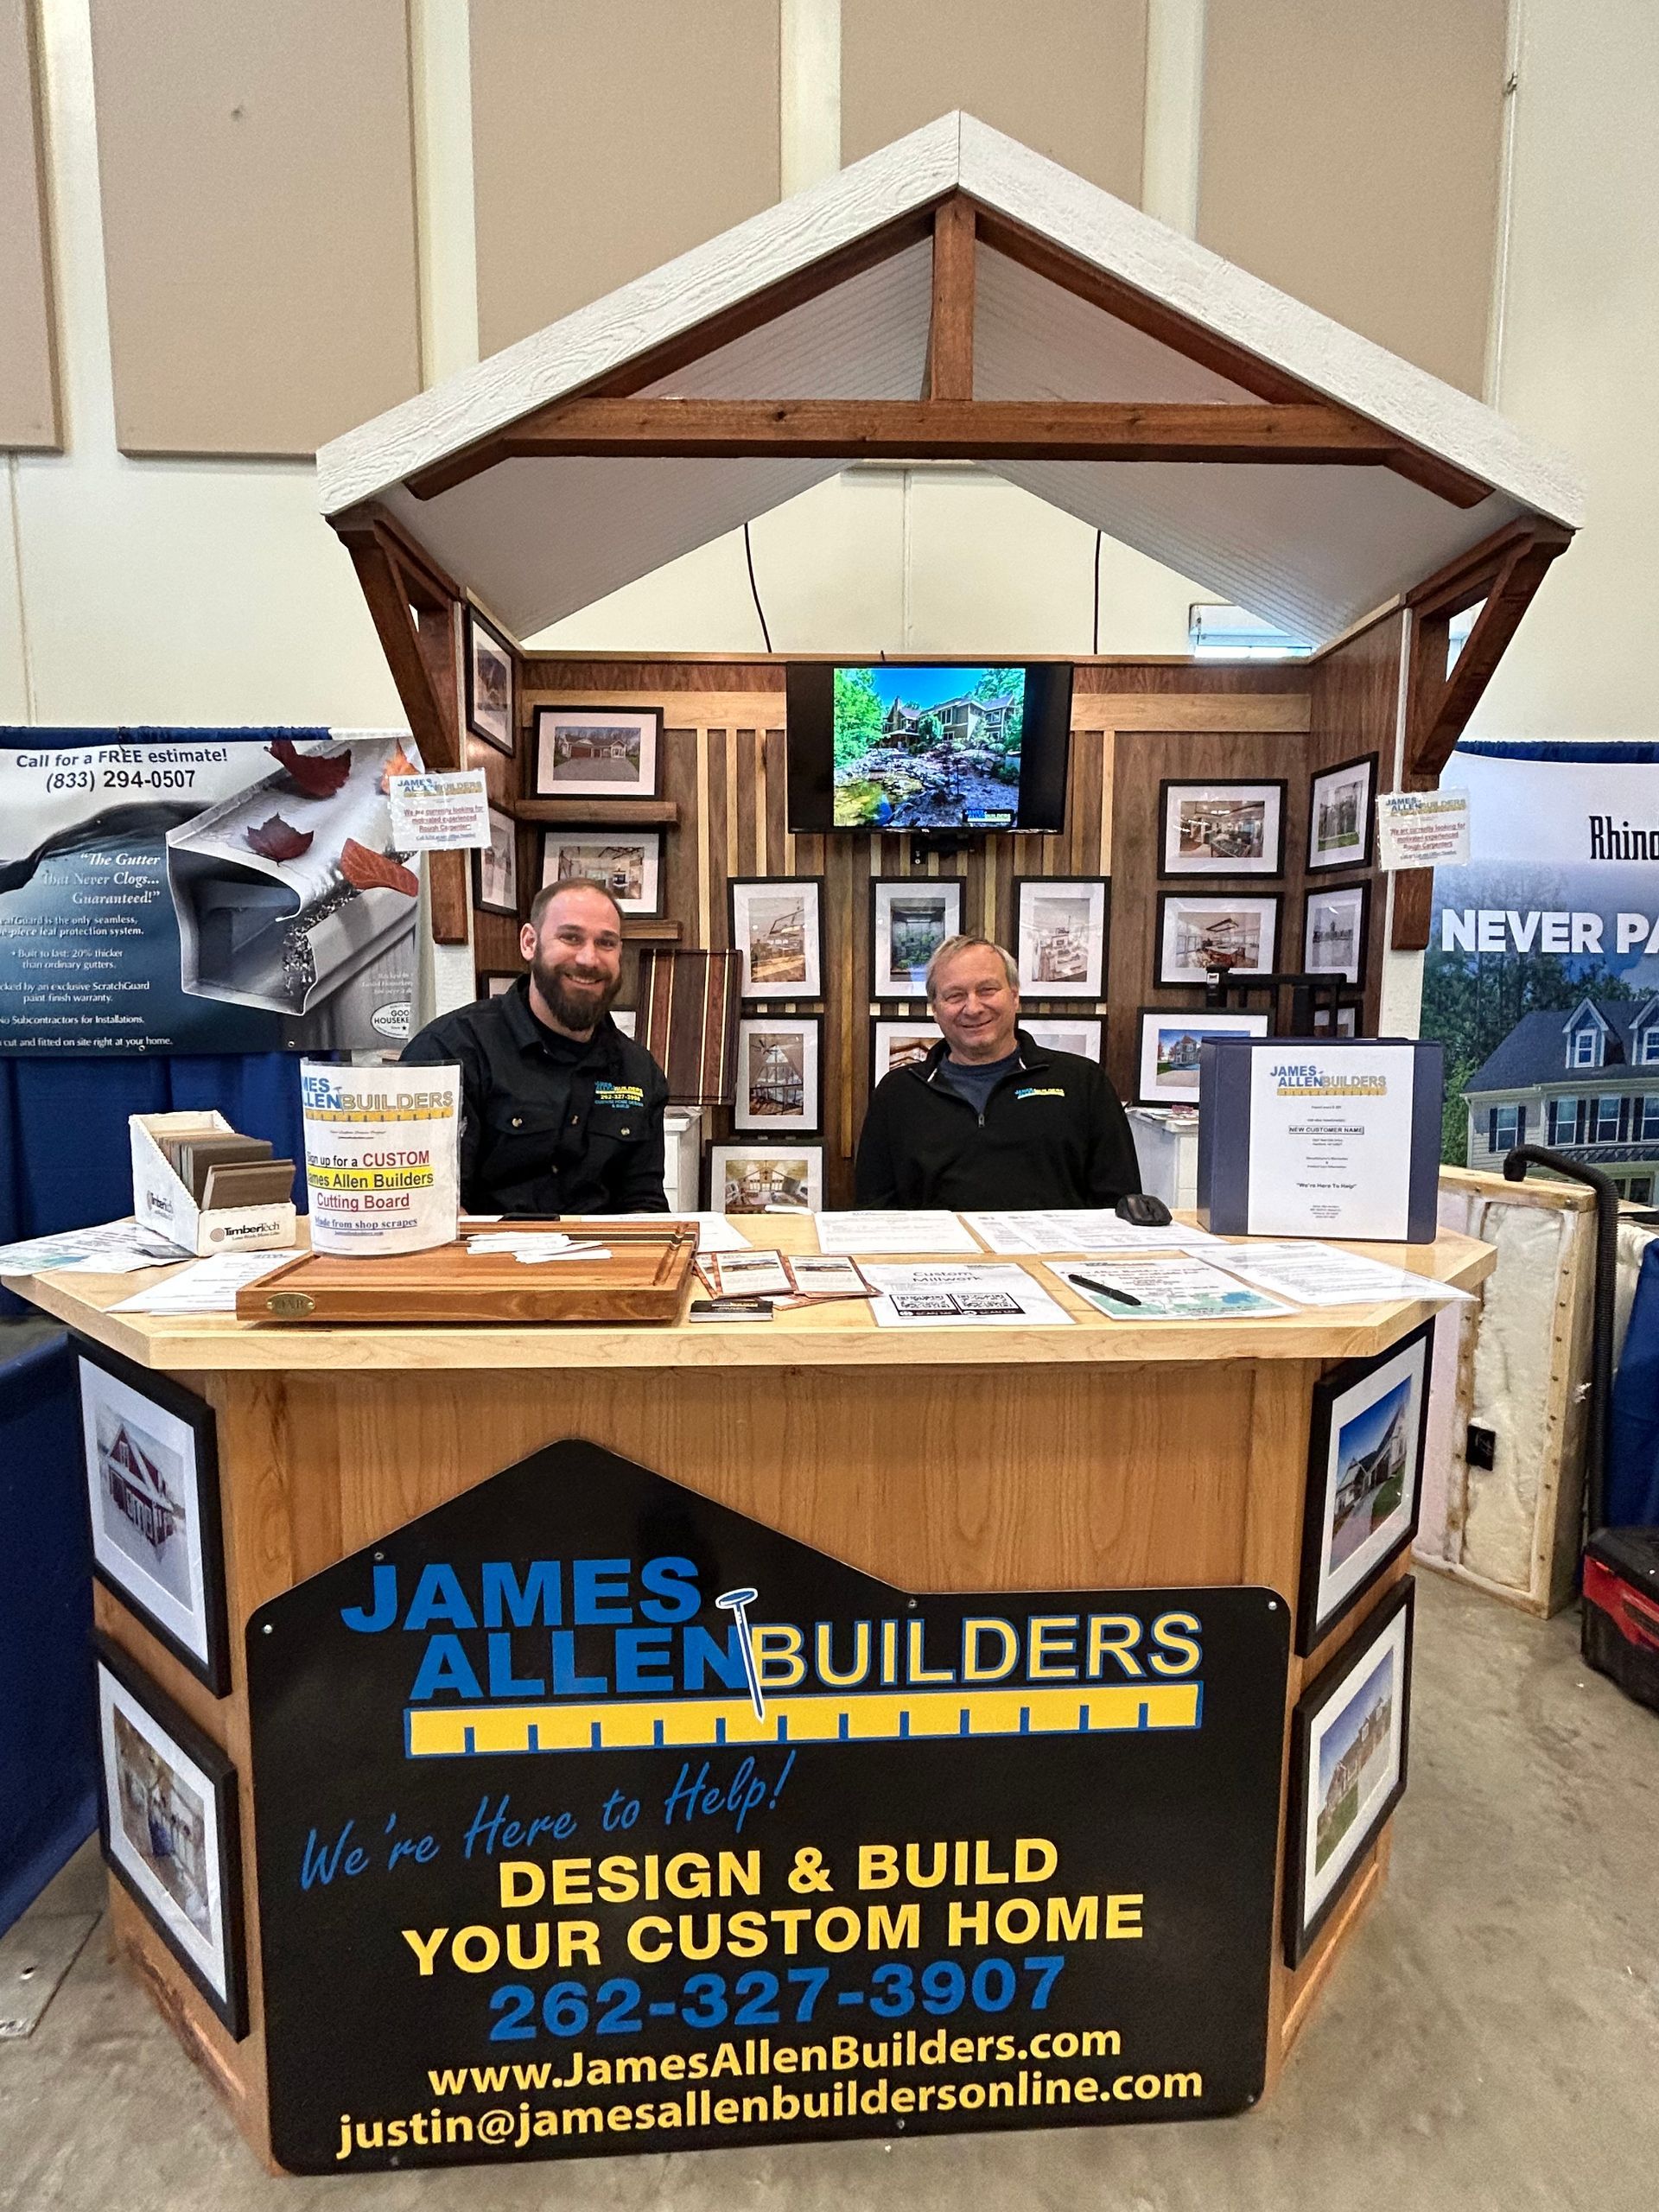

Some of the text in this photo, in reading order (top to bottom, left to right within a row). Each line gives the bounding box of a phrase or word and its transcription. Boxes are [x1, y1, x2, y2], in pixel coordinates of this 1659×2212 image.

[16, 748, 227, 767] Call for a FREE estimate!
[46, 770, 195, 792] (833) 294-0507
[1386, 797, 1417, 805] JAMES
[116, 853, 161, 866] Gutter
[43, 872, 160, 887] That Never Clogs...
[54, 916, 69, 925] the
[72, 915, 91, 925] only
[94, 915, 138, 925] seamless,
[59, 926, 107, 938] protection
[110, 926, 144, 937] system.
[1442, 908, 1605, 954] NEVER
[44, 961, 80, 970] ordinary
[84, 961, 116, 970] gutters.
[23, 982, 35, 993] by
[50, 982, 89, 991] exclusive
[92, 981, 150, 991] ScratchGuard
[23, 994, 113, 1005] paint finish warranty.
[12, 1014, 79, 1025] Subcontractors
[81, 1014, 92, 1023] for
[95, 1014, 145, 1024] Installations.
[20, 1038, 35, 1046] and
[37, 1037, 61, 1046] fitted
[76, 1038, 91, 1046] site
[93, 1037, 112, 1048] right
[125, 1038, 143, 1048] your
[145, 1036, 174, 1046] home.
[1270, 1065, 1317, 1077] JAMES
[1279, 1075, 1387, 1088] ALLEN BUILDERS
[339, 1090, 454, 1109] BUILDERS
[321, 1157, 331, 1167] up
[334, 1155, 347, 1166] for
[363, 1150, 430, 1166] CUSTOM
[333, 1173, 368, 1188] Allen
[373, 1173, 434, 1188] Builders
[317, 1192, 410, 1212] Cutting Board
[225, 1221, 280, 1236] TimberTech
[315, 1216, 417, 1230] Made from shop scrapes
[340, 1555, 702, 1635] JAMES
[409, 1611, 1203, 1702] ALLEN BUILDERS
[299, 1749, 797, 1891] We're Here to Help!
[499, 1837, 1059, 1909] DESIGN & BUILD
[402, 1892, 1145, 1977] YOUR CUSTOM HOME
[489, 1954, 1067, 2044] 262-327-3907
[427, 2024, 1122, 2097] www.JamesAllenBuilders.com
[335, 2065, 1204, 2162] justin@jamesallenbuildersonline.com
